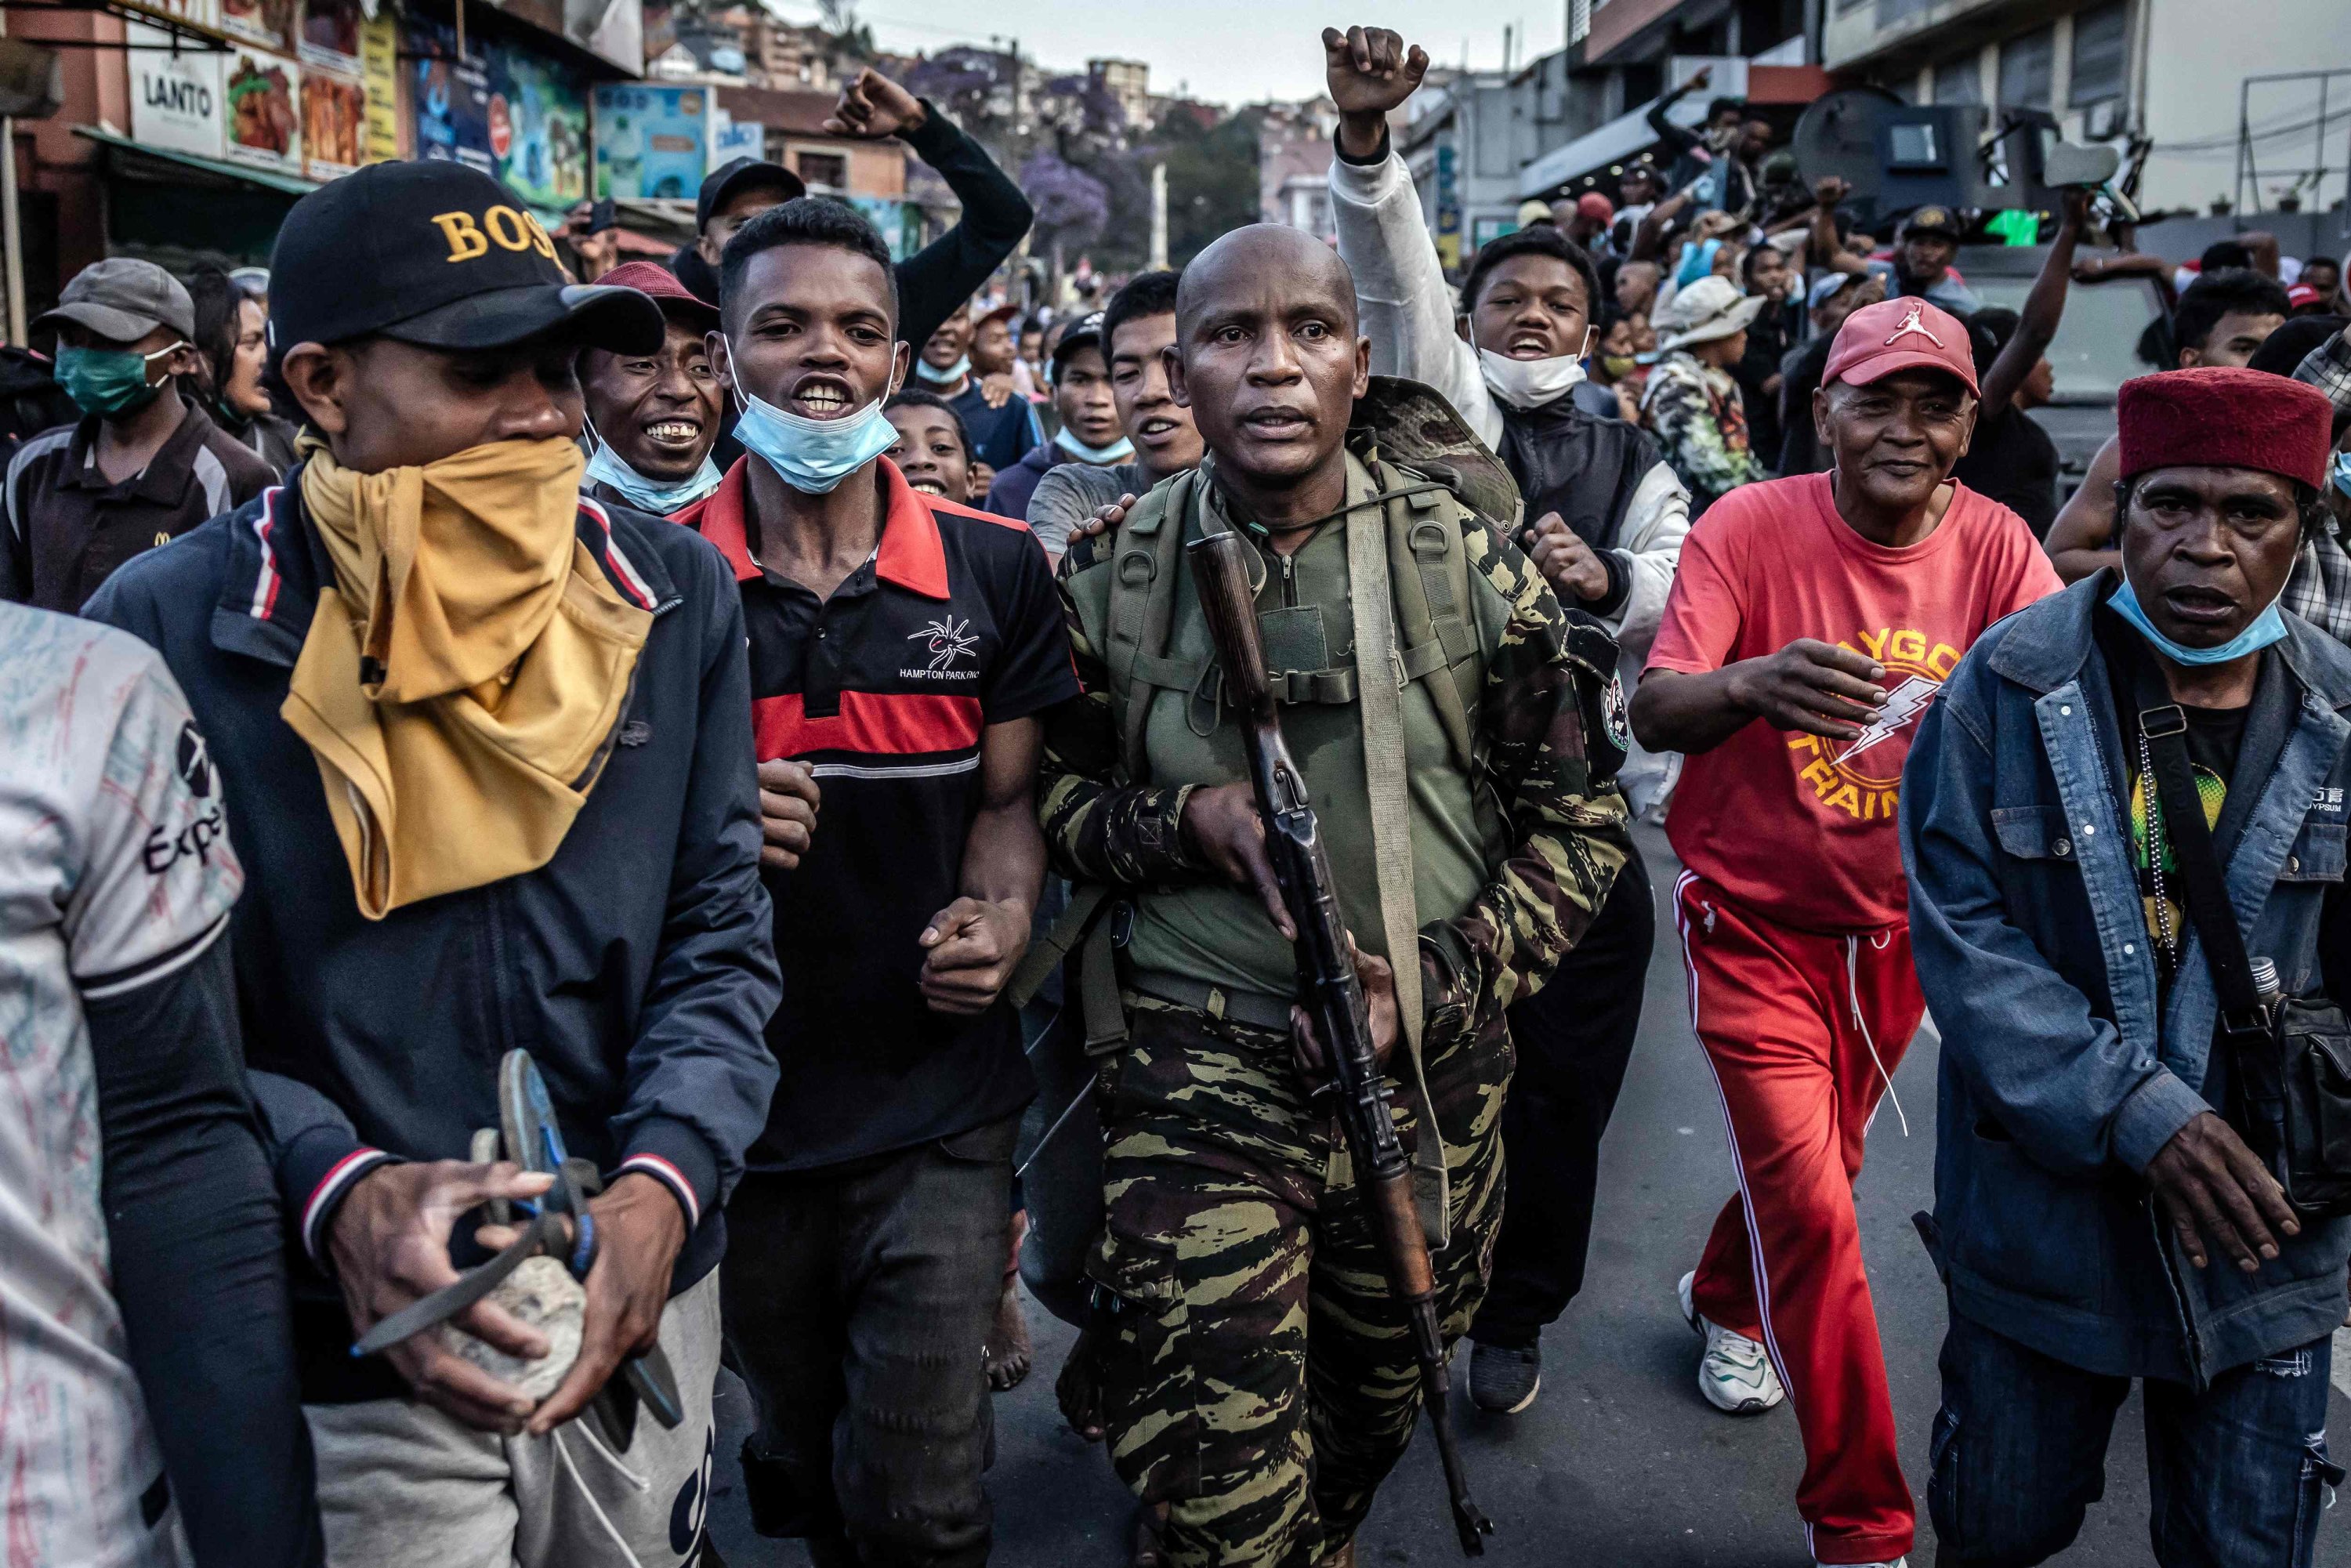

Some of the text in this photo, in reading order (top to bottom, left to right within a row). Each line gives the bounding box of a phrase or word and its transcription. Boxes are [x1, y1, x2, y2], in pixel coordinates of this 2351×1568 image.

[143, 70, 212, 117] LANTO
[900, 668, 944, 679] HAMPTON
[945, 671, 966, 679] PARK
